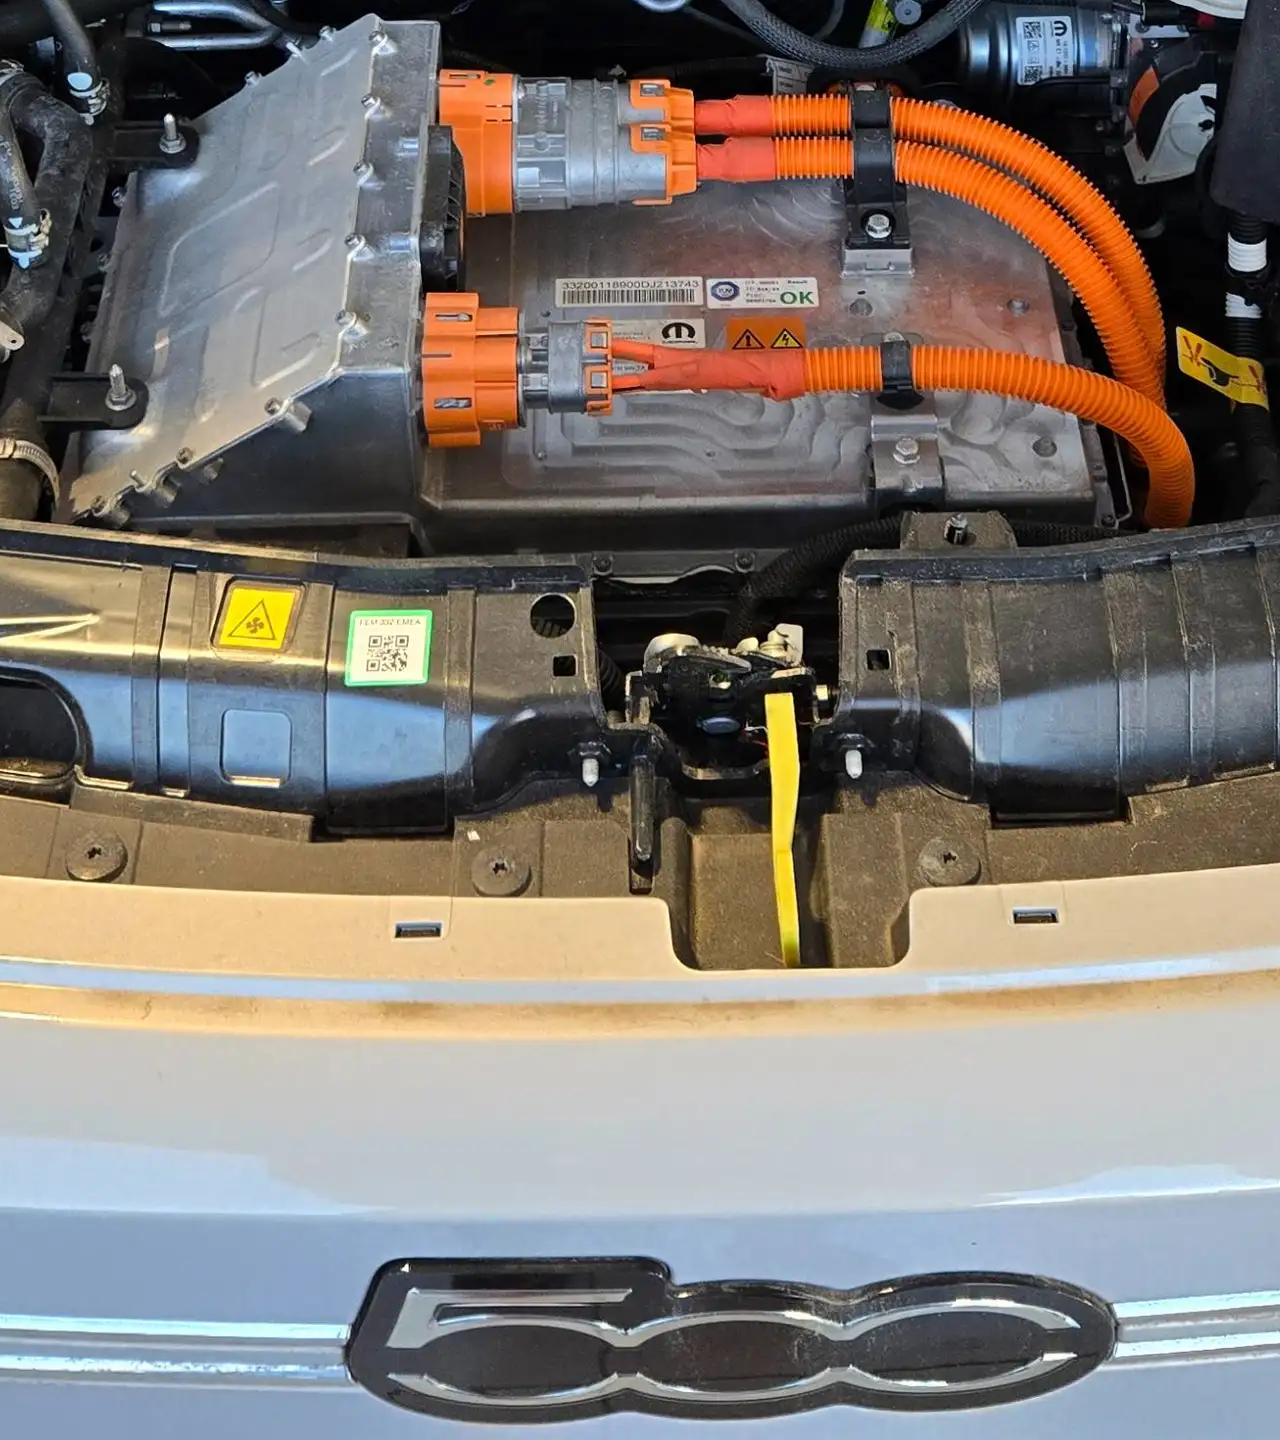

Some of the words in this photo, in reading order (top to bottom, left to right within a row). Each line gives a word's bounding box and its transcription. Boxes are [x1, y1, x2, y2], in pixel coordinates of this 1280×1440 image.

[780, 291, 815, 305] OK
[396, 618, 422, 626] EMEA
[378, 1282, 1088, 1402] 500
